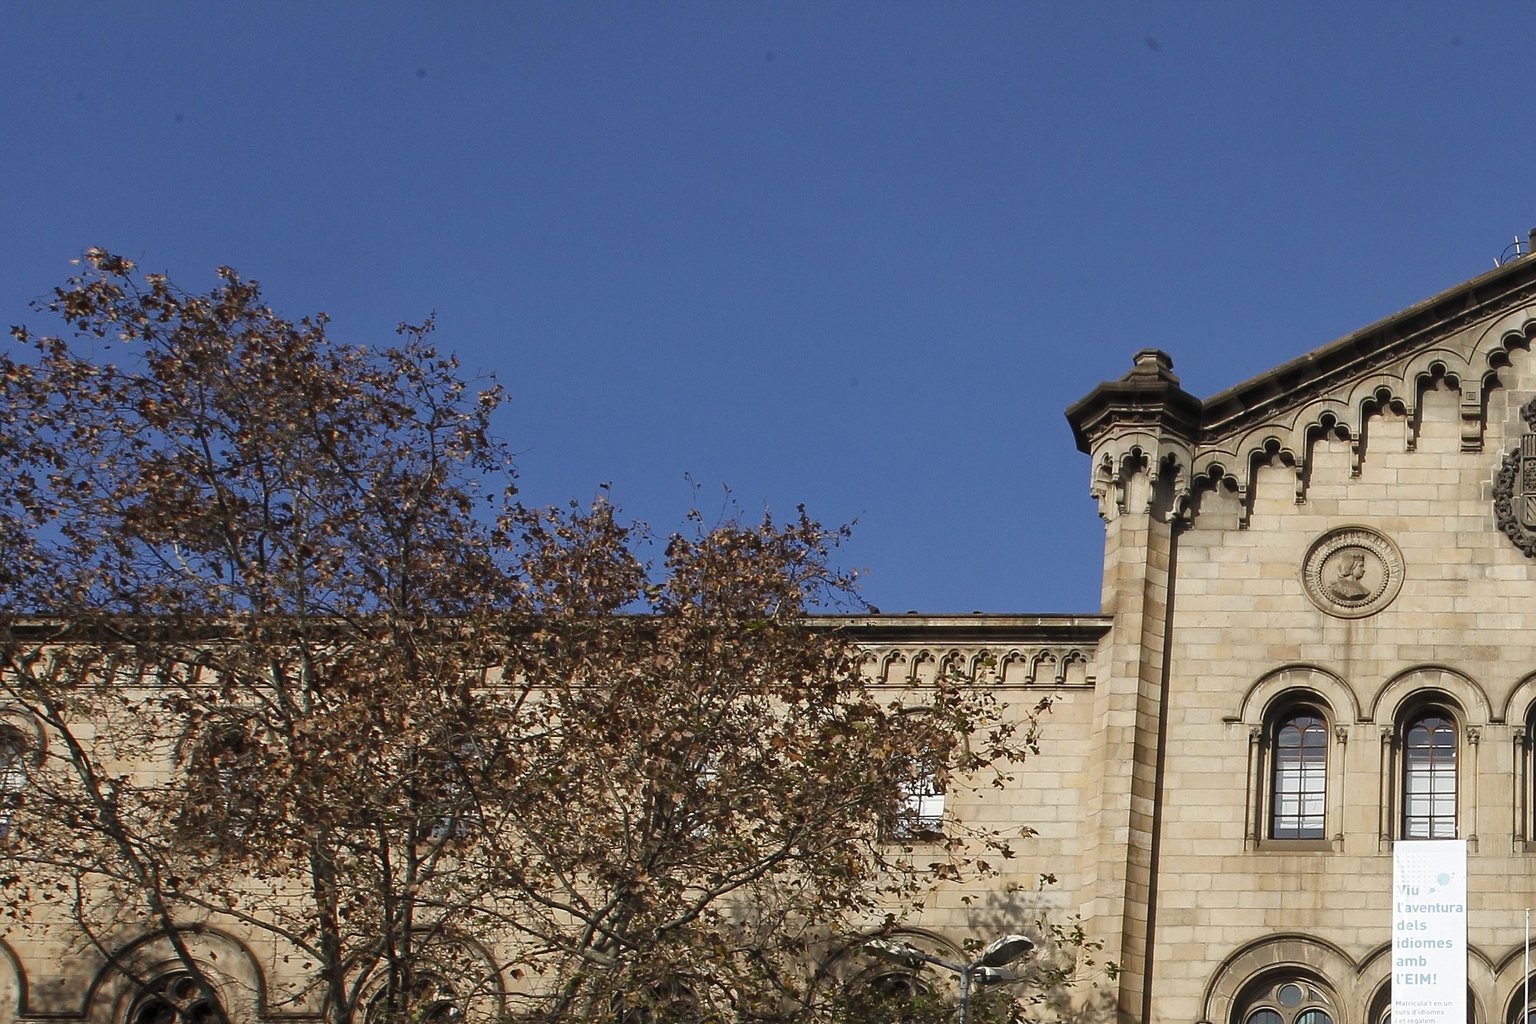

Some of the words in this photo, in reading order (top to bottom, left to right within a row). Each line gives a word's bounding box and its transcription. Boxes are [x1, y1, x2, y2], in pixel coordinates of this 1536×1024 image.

[1397, 902, 1464, 913] l'aventura
[1396, 919, 1427, 931] dels
[1396, 937, 1453, 949] idiomes
[1396, 955, 1427, 967] amb
[1396, 973, 1437, 985] l'EIM!
